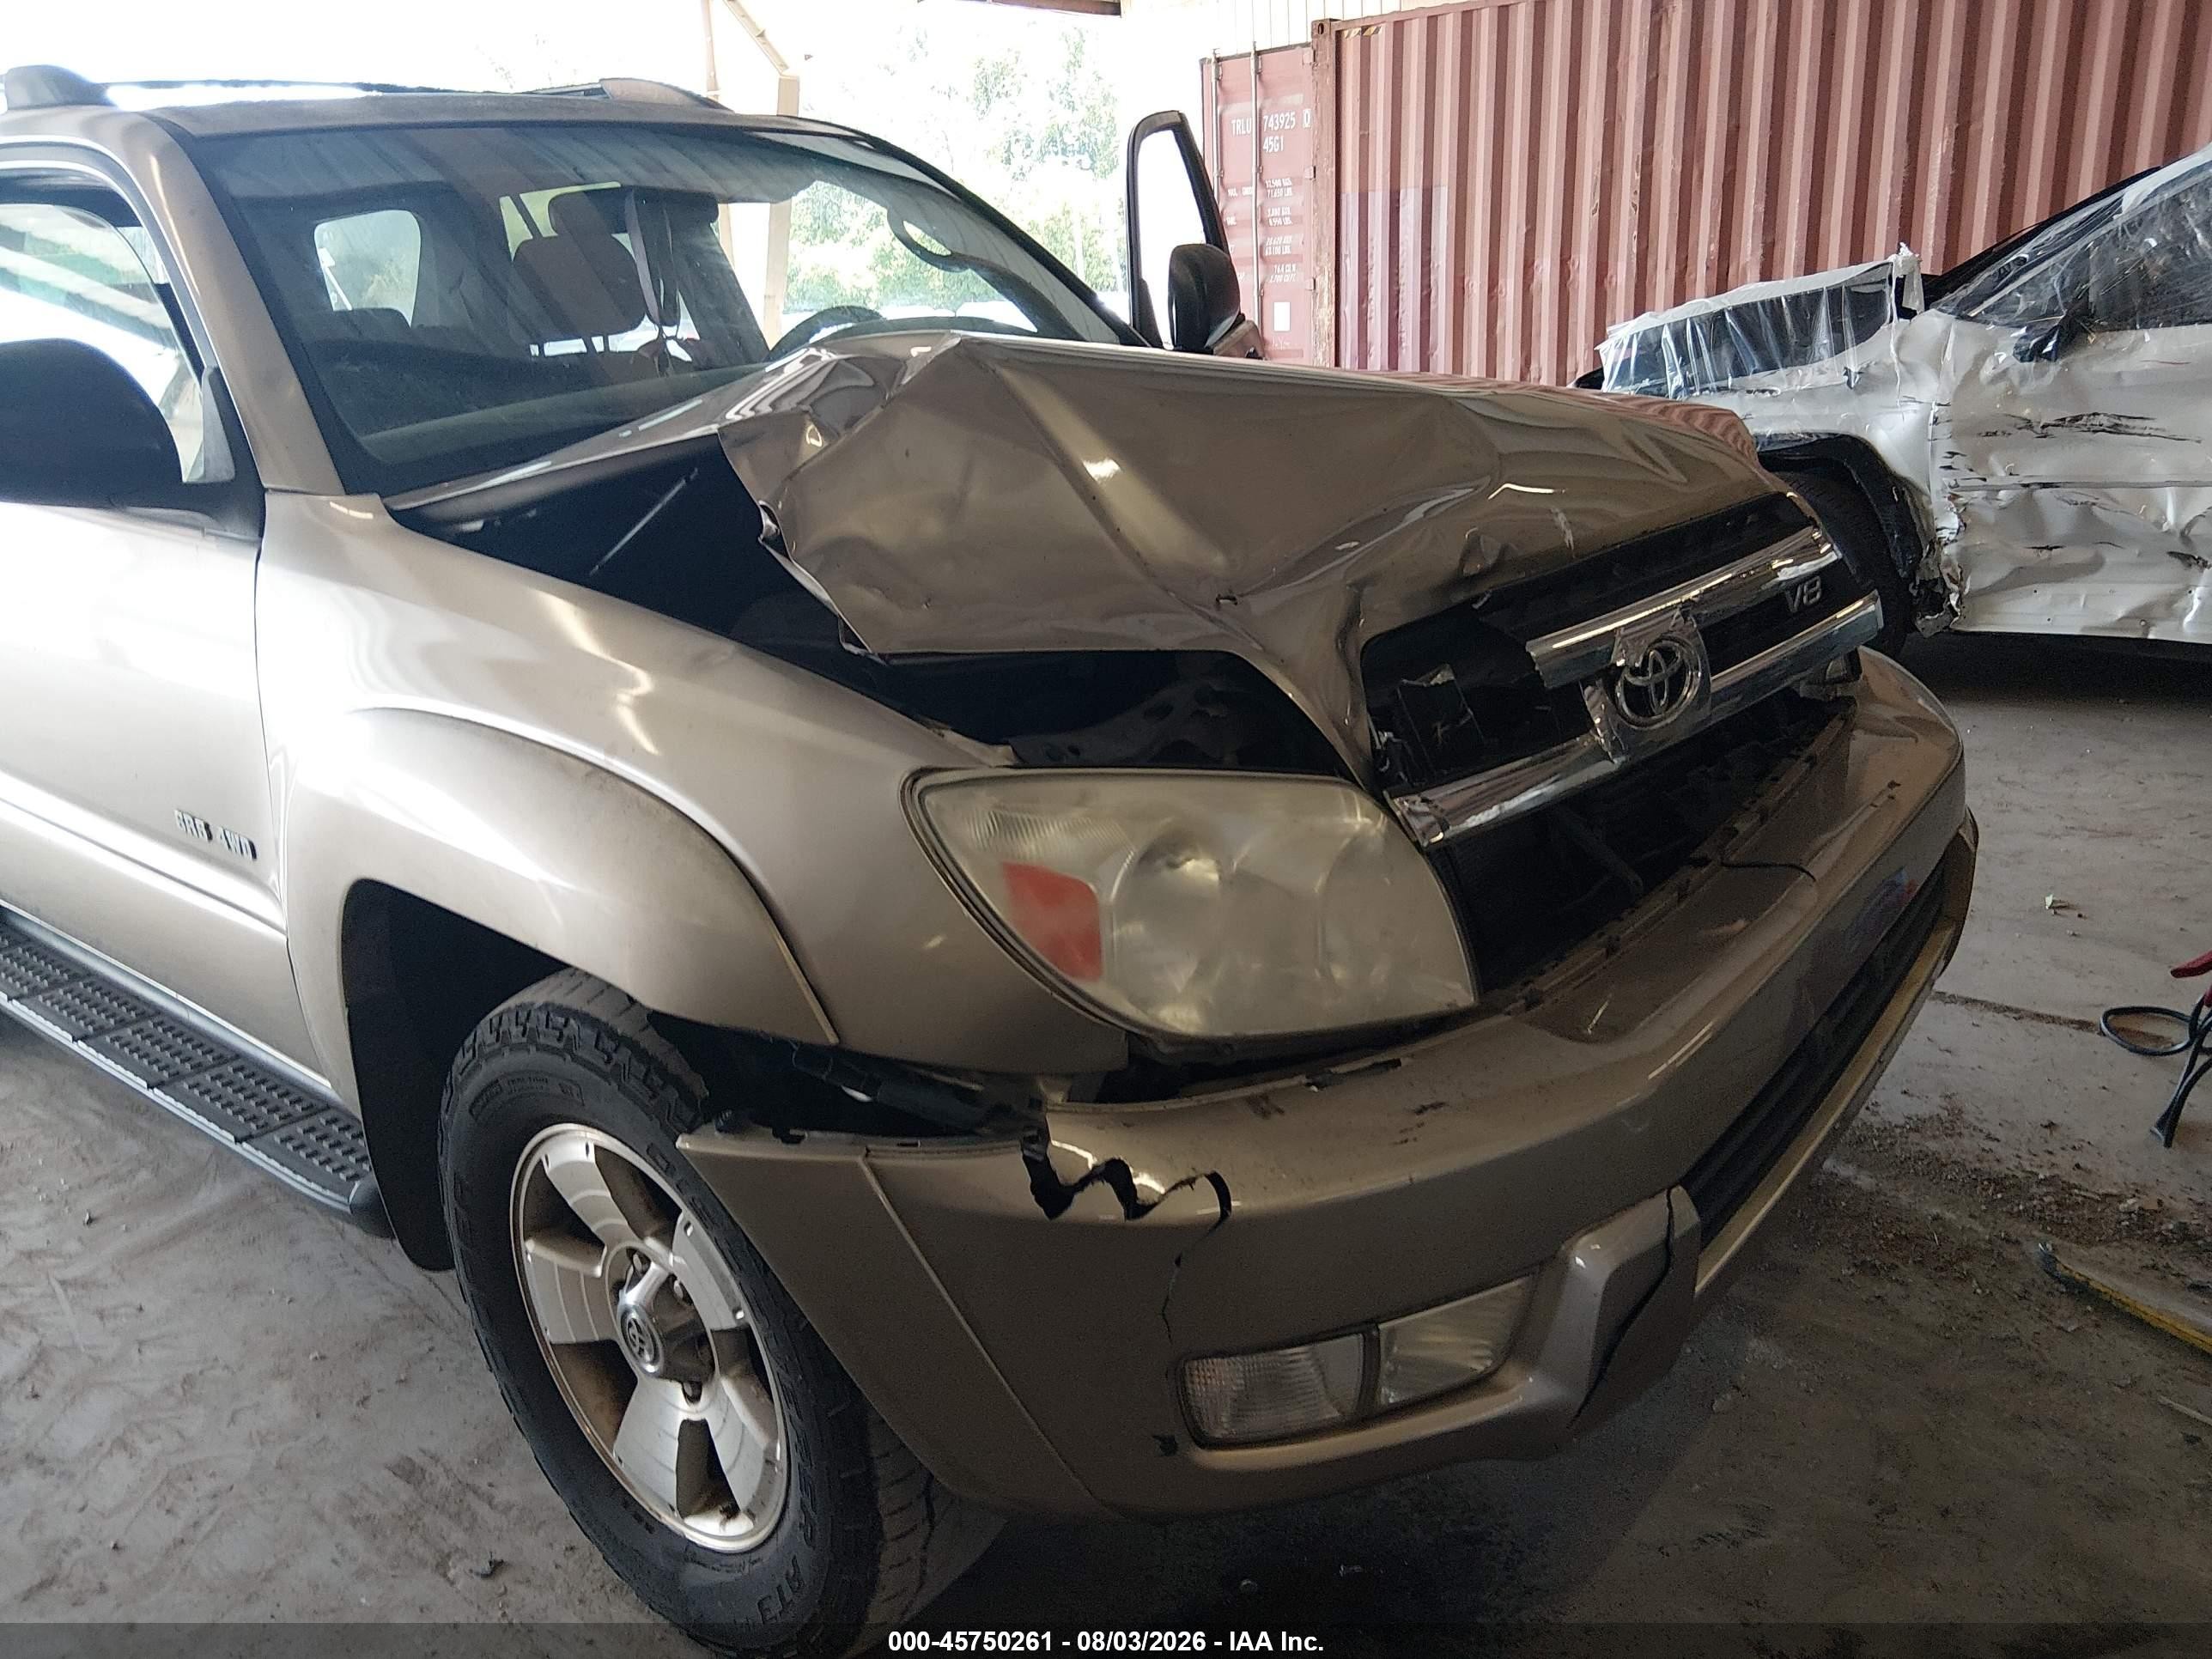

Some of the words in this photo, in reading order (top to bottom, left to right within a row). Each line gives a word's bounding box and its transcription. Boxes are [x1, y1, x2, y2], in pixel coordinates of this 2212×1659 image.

[1231, 118, 1252, 136] TRLU
[1263, 112, 1296, 132] 743925
[1263, 136, 1284, 153] 45G1
[218, 826, 258, 861] 4WD
